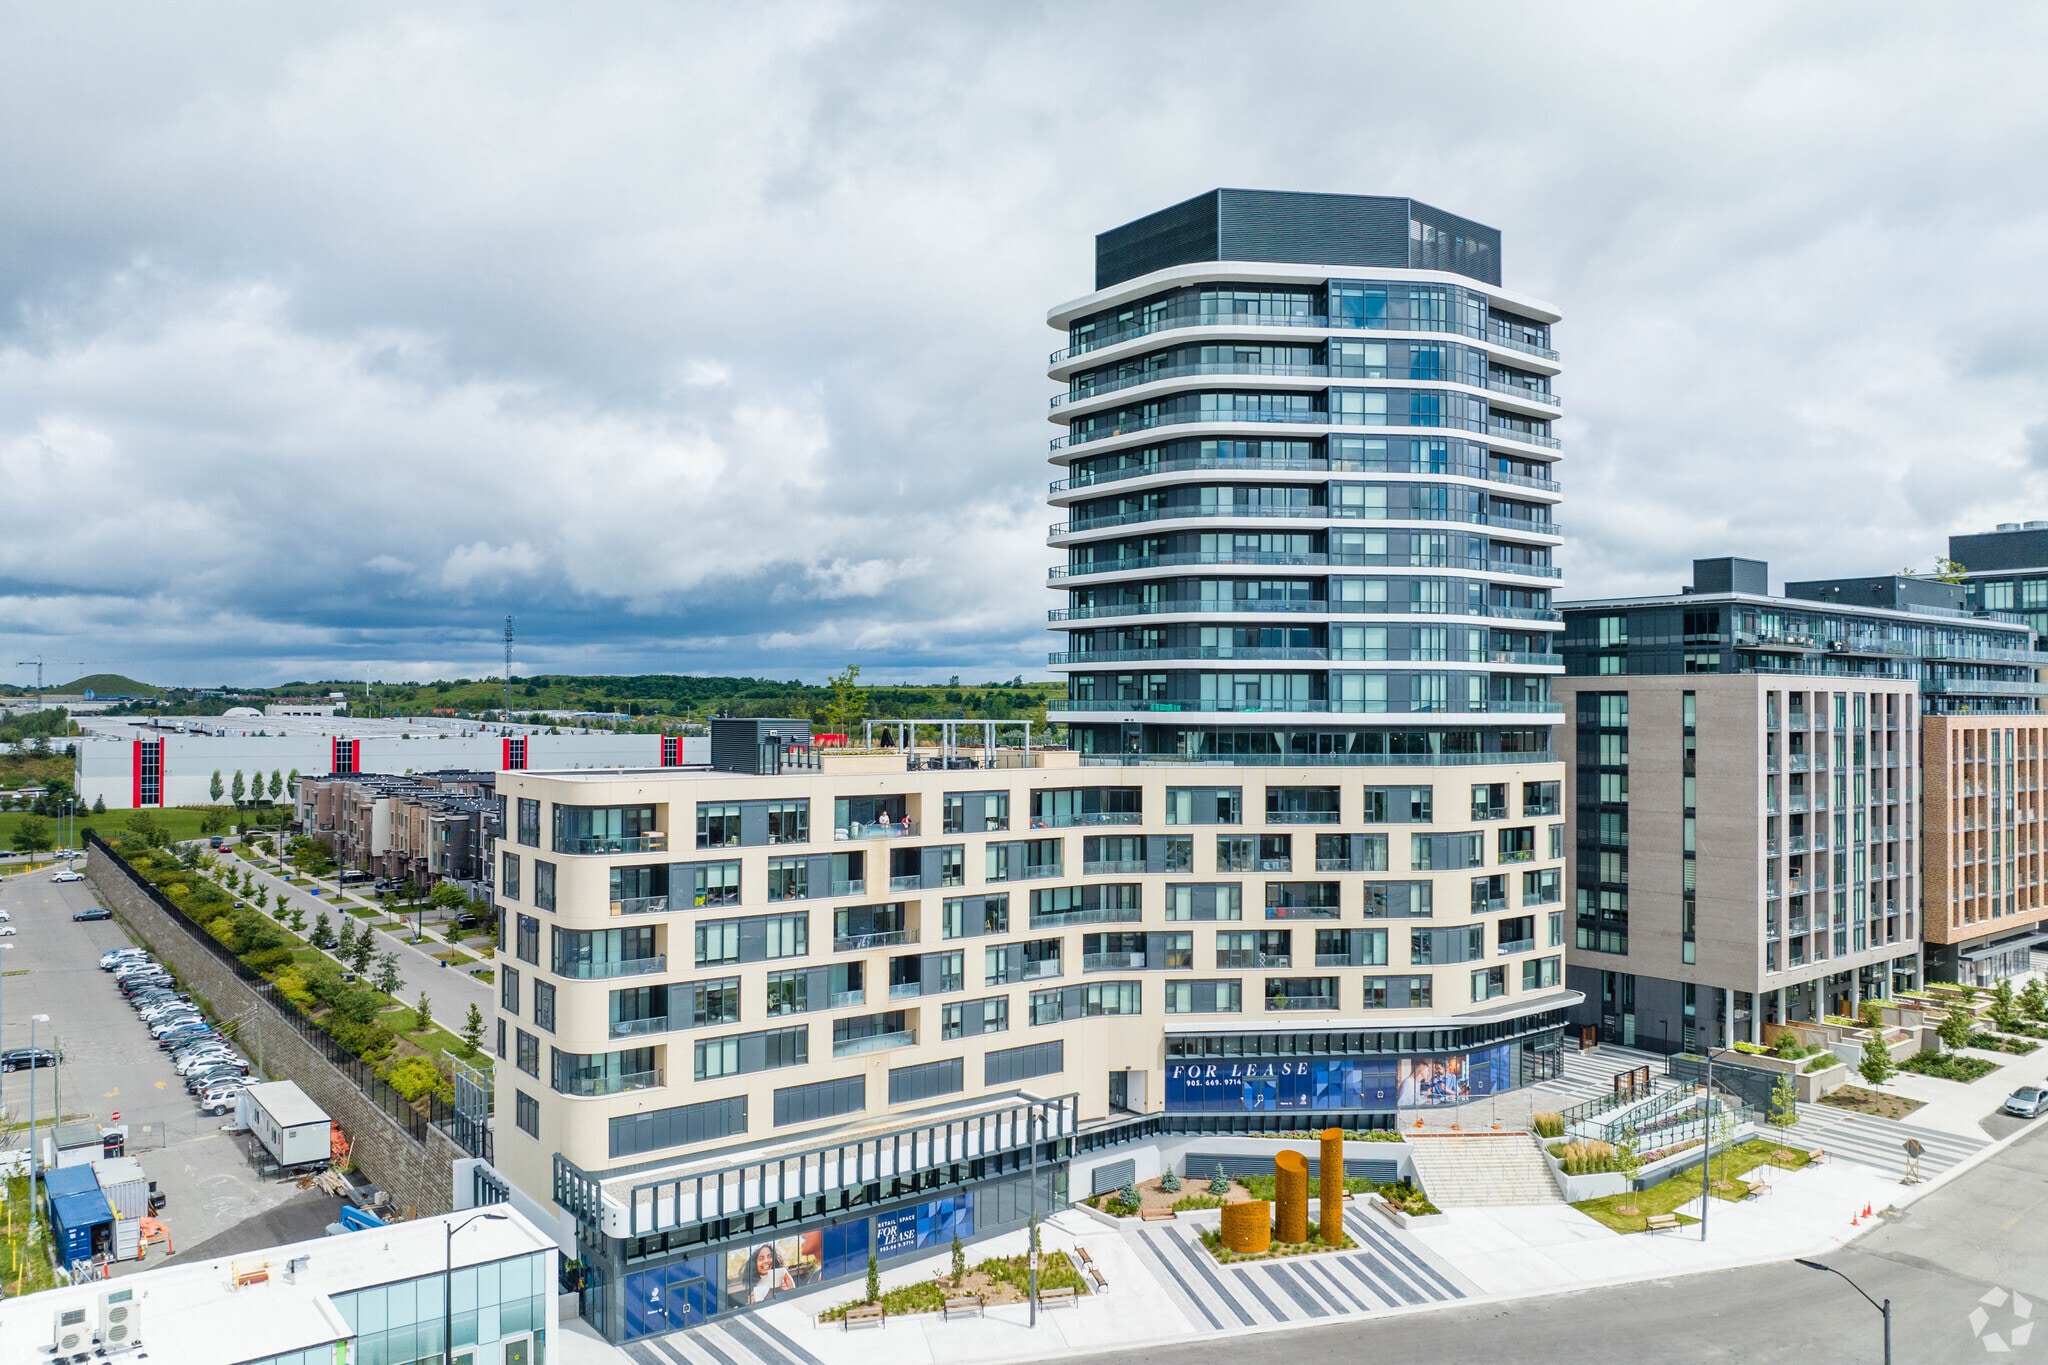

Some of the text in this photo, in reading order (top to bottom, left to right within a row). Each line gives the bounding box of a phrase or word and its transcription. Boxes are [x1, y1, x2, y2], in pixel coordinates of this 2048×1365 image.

[1173, 1062, 1308, 1078] FOR LEASE
[878, 1214, 915, 1228] RETAIL SPACE
[877, 1225, 897, 1239] FOR
[884, 1229, 915, 1245] LEASE
